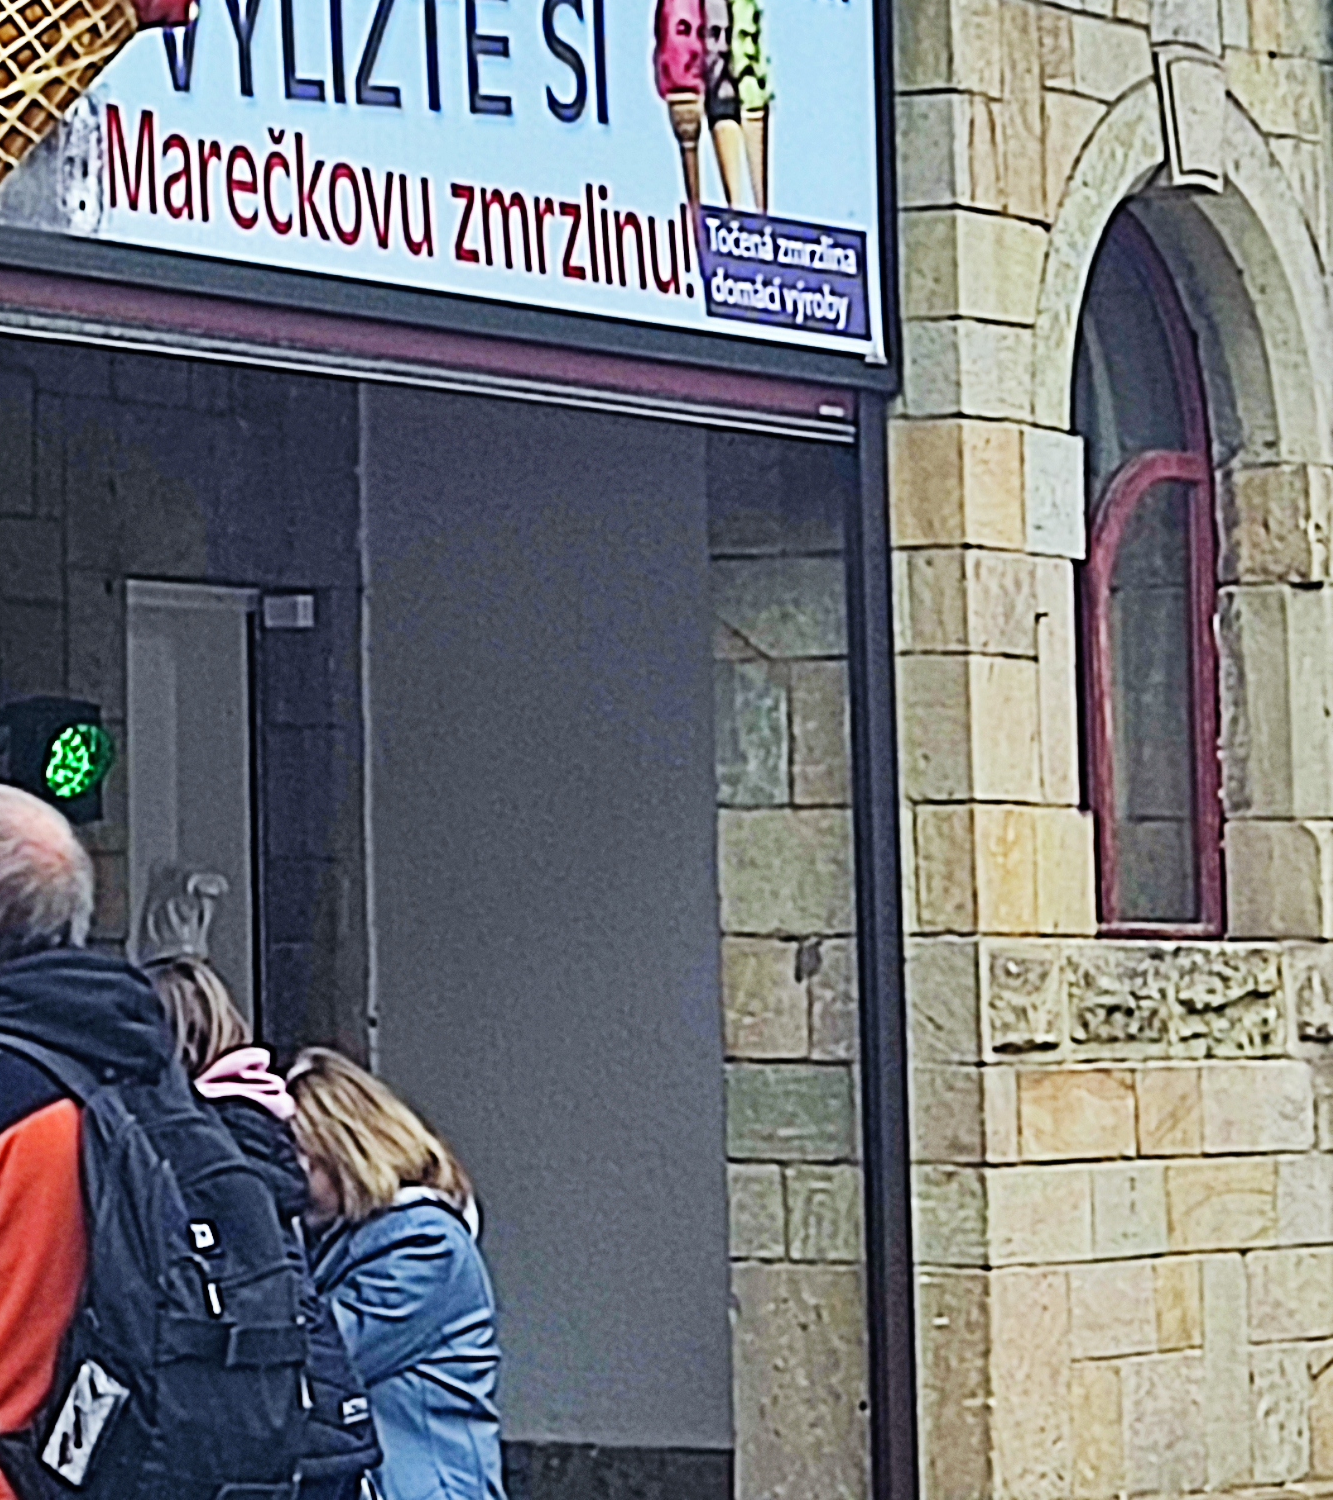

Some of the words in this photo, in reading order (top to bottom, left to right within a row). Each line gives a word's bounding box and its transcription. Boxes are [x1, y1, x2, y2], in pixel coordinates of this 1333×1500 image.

[105, 104, 434, 259] Marečkovu
[451, 183, 695, 298] zmrzlinu!
[705, 218, 774, 261] Točená
[776, 234, 858, 275] zmrzlina
[710, 266, 782, 312] domácí
[783, 279, 849, 331] výroby
